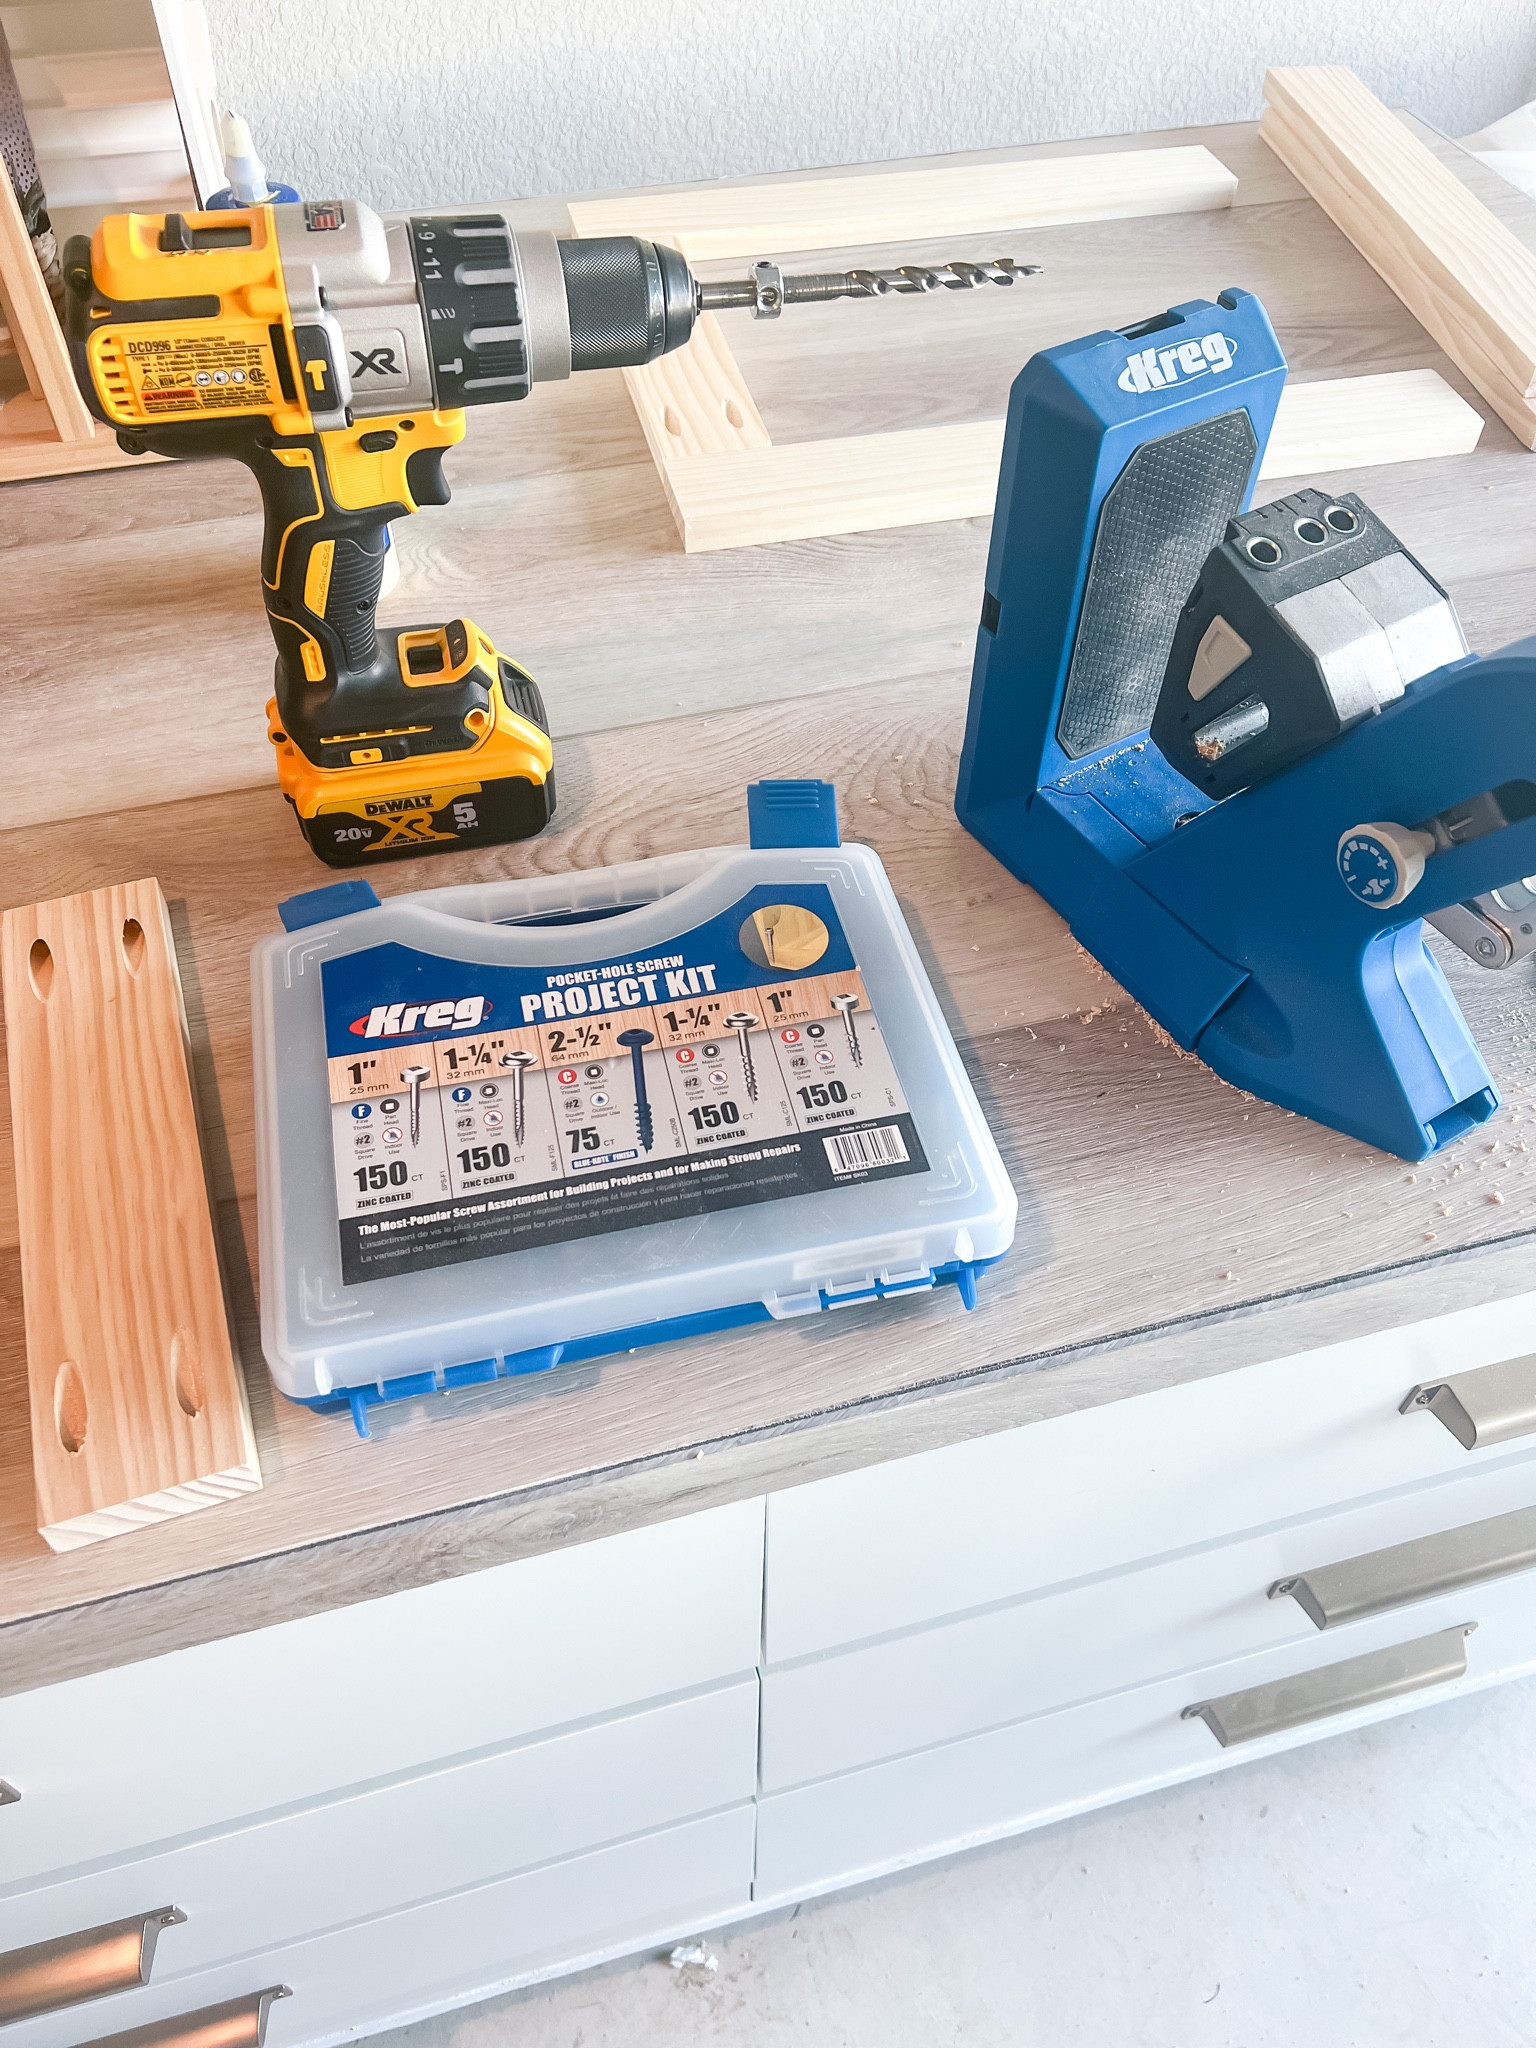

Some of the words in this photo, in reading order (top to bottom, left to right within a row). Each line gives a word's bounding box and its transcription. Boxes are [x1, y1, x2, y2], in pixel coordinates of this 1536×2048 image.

[423, 257, 443, 280] 11
[128, 340, 171, 353] DCD996
[350, 347, 402, 378] XR
[1126, 332, 1233, 394] Kreg
[365, 795, 433, 816] DEWALT
[452, 802, 477, 823] 5
[376, 812, 440, 845] XR
[456, 821, 479, 830] AH
[546, 962, 634, 989] POCKET-HOLE
[636, 955, 684, 973] SCREW
[520, 973, 662, 1023] PROJECT
[665, 964, 717, 998] KIT
[767, 990, 792, 1013] 1"
[365, 996, 485, 1038] Kreg
[773, 1015, 787, 1023] 25
[789, 1011, 809, 1019] mm
[685, 1030, 705, 1038] mm
[568, 1051, 589, 1059] mm
[792, 1058, 806, 1067] #2
[348, 1060, 376, 1084] 1"
[464, 1068, 485, 1076] mm
[684, 1078, 699, 1087] #2
[367, 1083, 389, 1092] mm
[796, 1080, 848, 1109] 150
[565, 1100, 579, 1109] #2
[458, 1118, 472, 1128] #2
[688, 1101, 739, 1130] 150
[806, 1114, 824, 1124] ZINC
[826, 1109, 855, 1120] COATED
[356, 1135, 370, 1145] #2
[566, 1126, 600, 1153] 75
[696, 1135, 714, 1145] ZINC
[716, 1129, 746, 1141] COATED
[457, 1143, 510, 1173] 150
[514, 1155, 526, 1163] CT
[612, 1150, 636, 1162] FINISH
[353, 1161, 408, 1192] 150
[411, 1174, 423, 1182] CT
[462, 1178, 481, 1189] ZINC
[483, 1173, 515, 1185] COATED
[358, 1225, 379, 1235] The
[380, 1211, 451, 1231] Most-Popular
[453, 1204, 487, 1217] Screw
[487, 1192, 549, 1211] Assortment
[549, 1189, 565, 1200] for
[565, 1180, 610, 1196] Building
[610, 1172, 653, 1187] Projects
[654, 1168, 674, 1179] and
[674, 1165, 689, 1175] for
[691, 1159, 728, 1172] Making
[728, 1151, 762, 1164] Strong
[762, 1143, 801, 1158] Repairs
[357, 1197, 377, 1208] ZINC
[379, 1192, 411, 1204] COATED
[361, 1255, 372, 1263] La
[374, 1248, 410, 1260] variedad
[425, 1239, 458, 1250] tornillos
[480, 1229, 511, 1240] popular
[513, 1225, 531, 1234] para
[547, 1213, 588, 1227] proyectos
[660, 1196, 678, 1205] para
[680, 1191, 702, 1199] hacer
[454, 1223, 470, 1232] plus
[513, 1211, 531, 1220] pour
